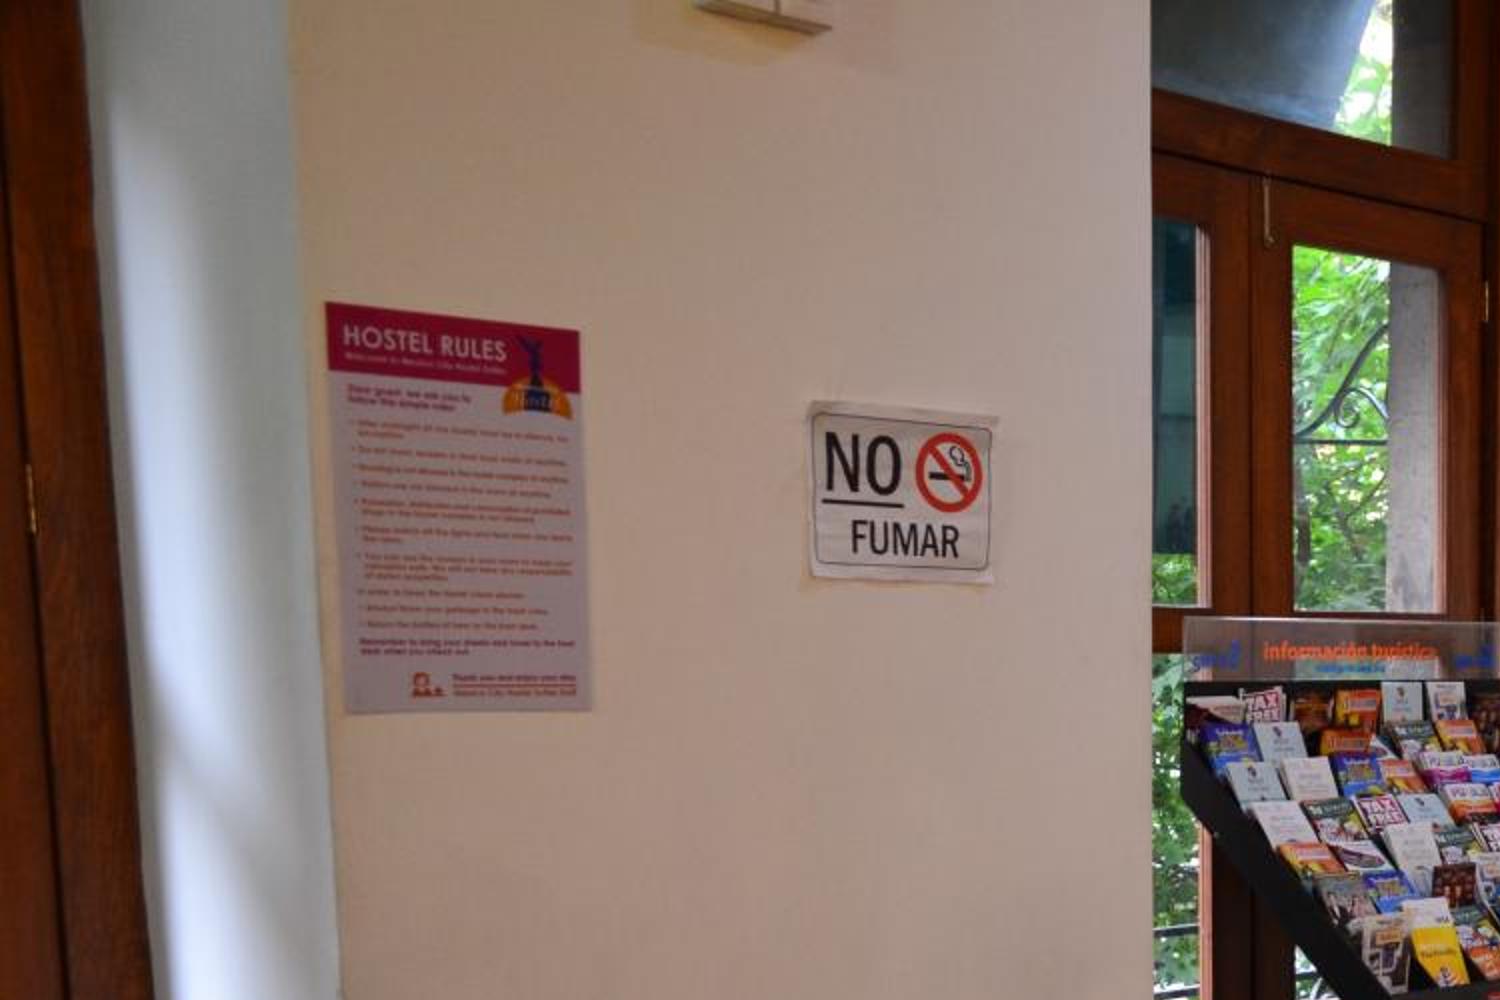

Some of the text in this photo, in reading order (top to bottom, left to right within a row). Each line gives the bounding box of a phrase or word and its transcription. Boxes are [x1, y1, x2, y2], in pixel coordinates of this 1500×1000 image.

[342, 324, 507, 362] HOSTEL RULES
[825, 431, 902, 496] NO
[851, 519, 960, 559] FUMAR
